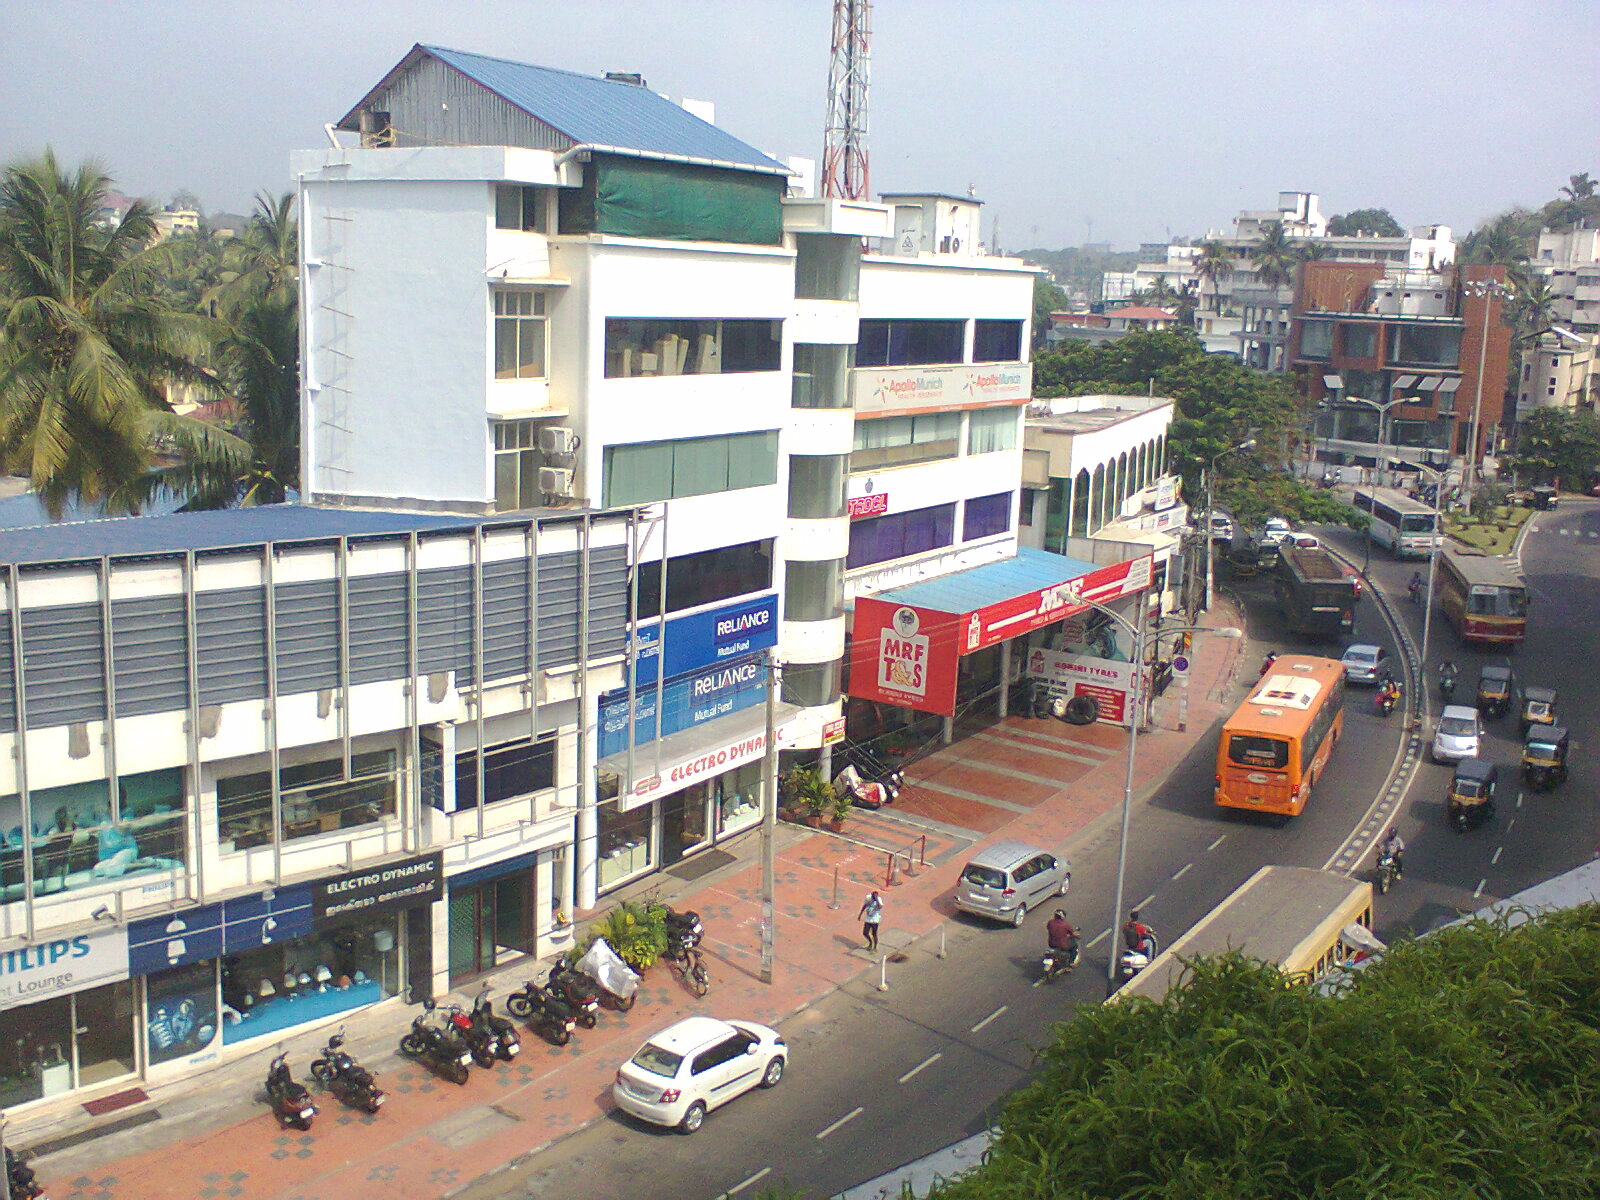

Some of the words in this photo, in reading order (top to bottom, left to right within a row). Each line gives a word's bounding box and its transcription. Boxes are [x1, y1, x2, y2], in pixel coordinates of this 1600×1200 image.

[884, 638, 925, 662] MRF
[694, 704, 718, 722] Mutual
[671, 751, 727, 782] ELECTRO
[327, 874, 380, 894] ELECTRO
[382, 860, 434, 882] DYNAMIC
[0, 935, 91, 976] ILIPS
[18, 972, 73, 994] Lounge
